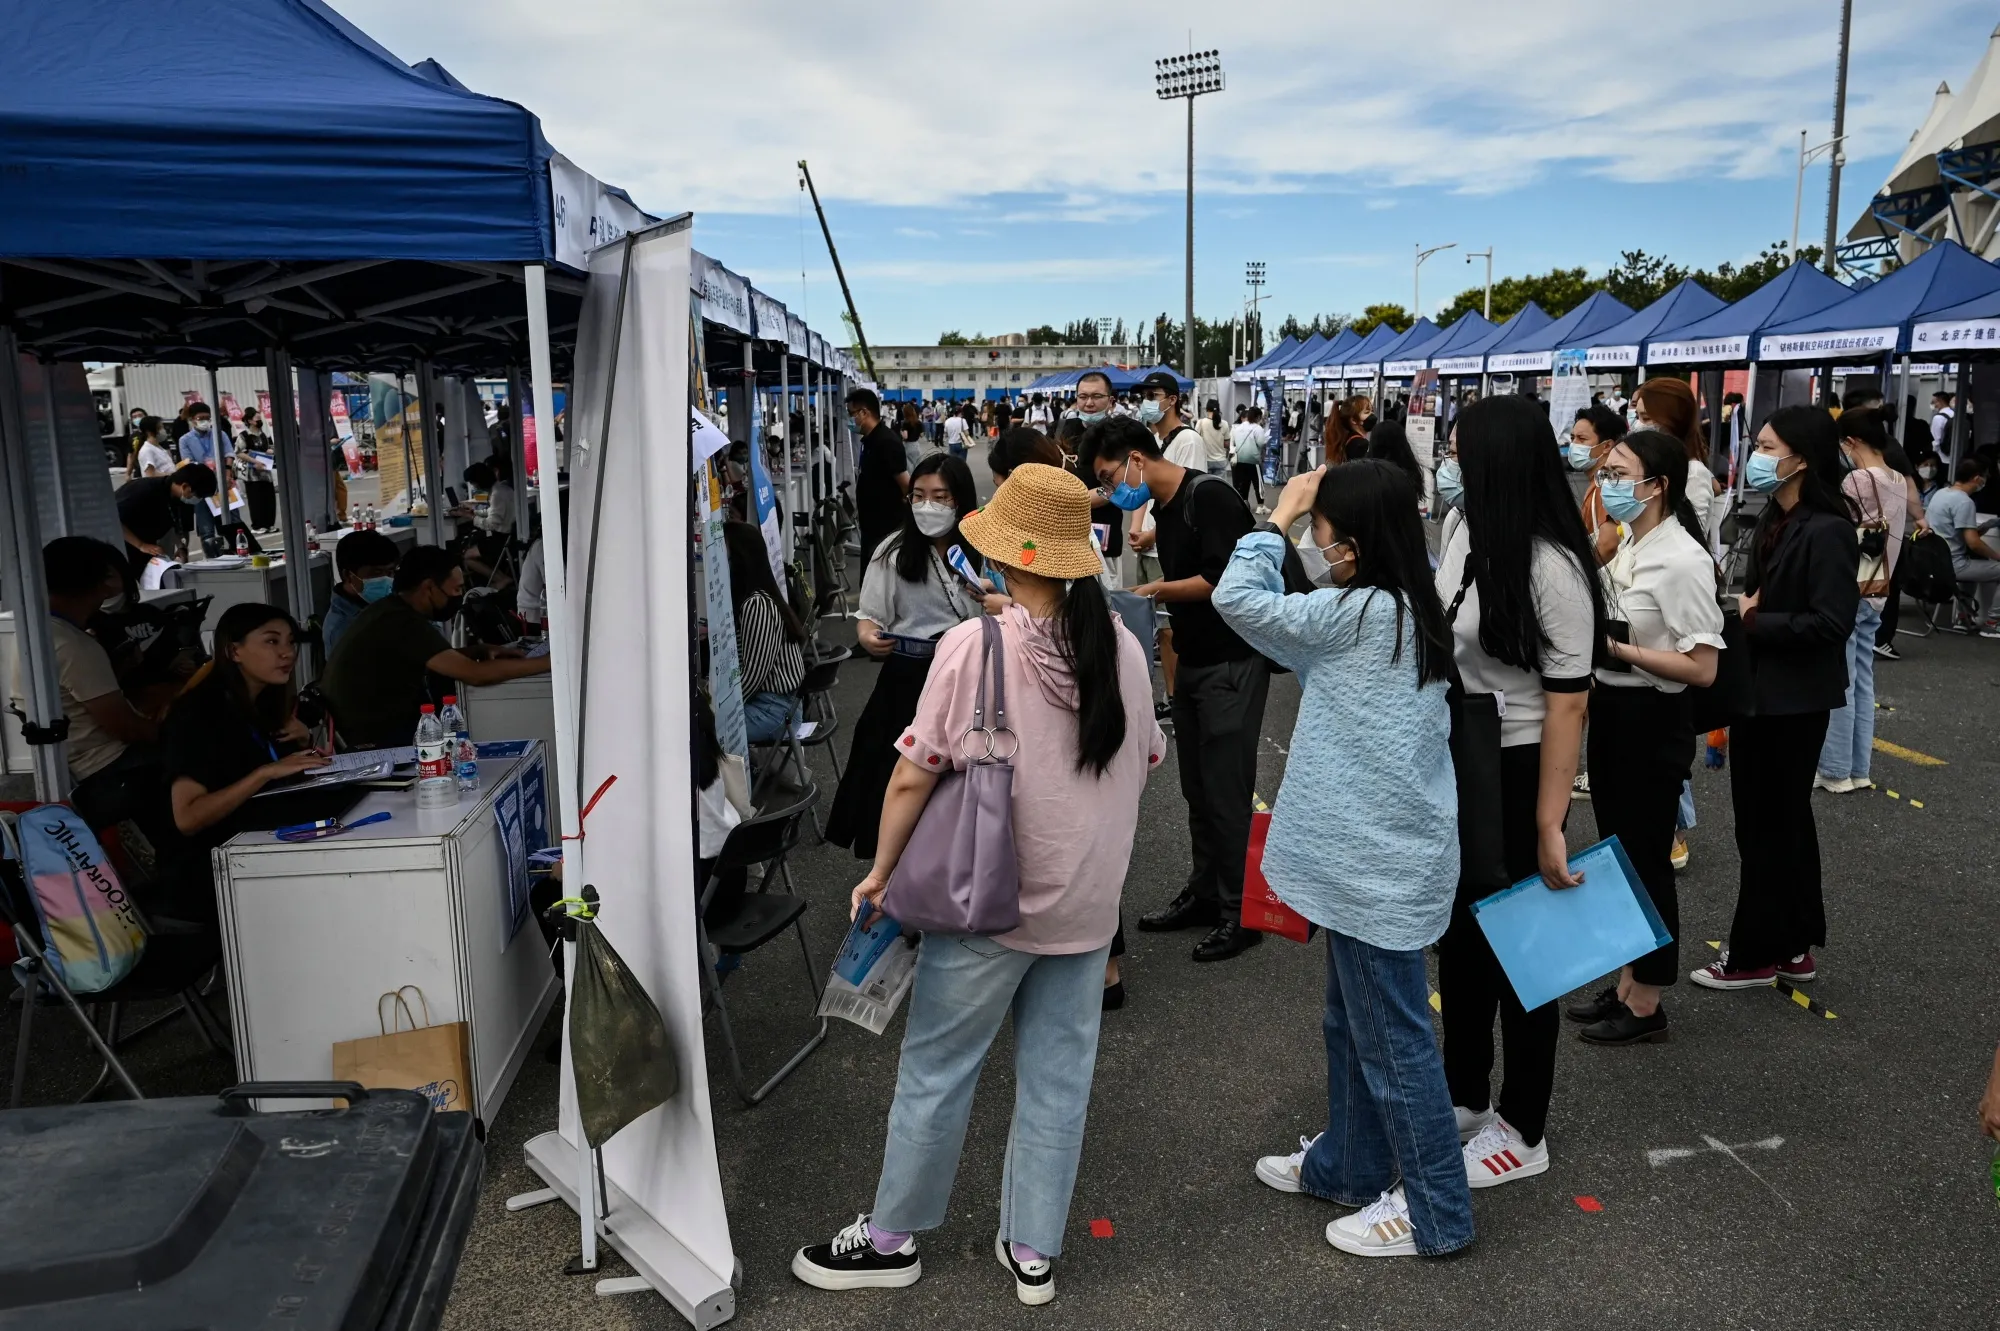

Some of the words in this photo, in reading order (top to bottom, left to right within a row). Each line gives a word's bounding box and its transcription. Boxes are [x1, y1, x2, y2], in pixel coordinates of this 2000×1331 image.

[555, 193, 566, 228] 46
[1917, 332, 1928, 342] 42
[1762, 344, 1771, 353] 41
